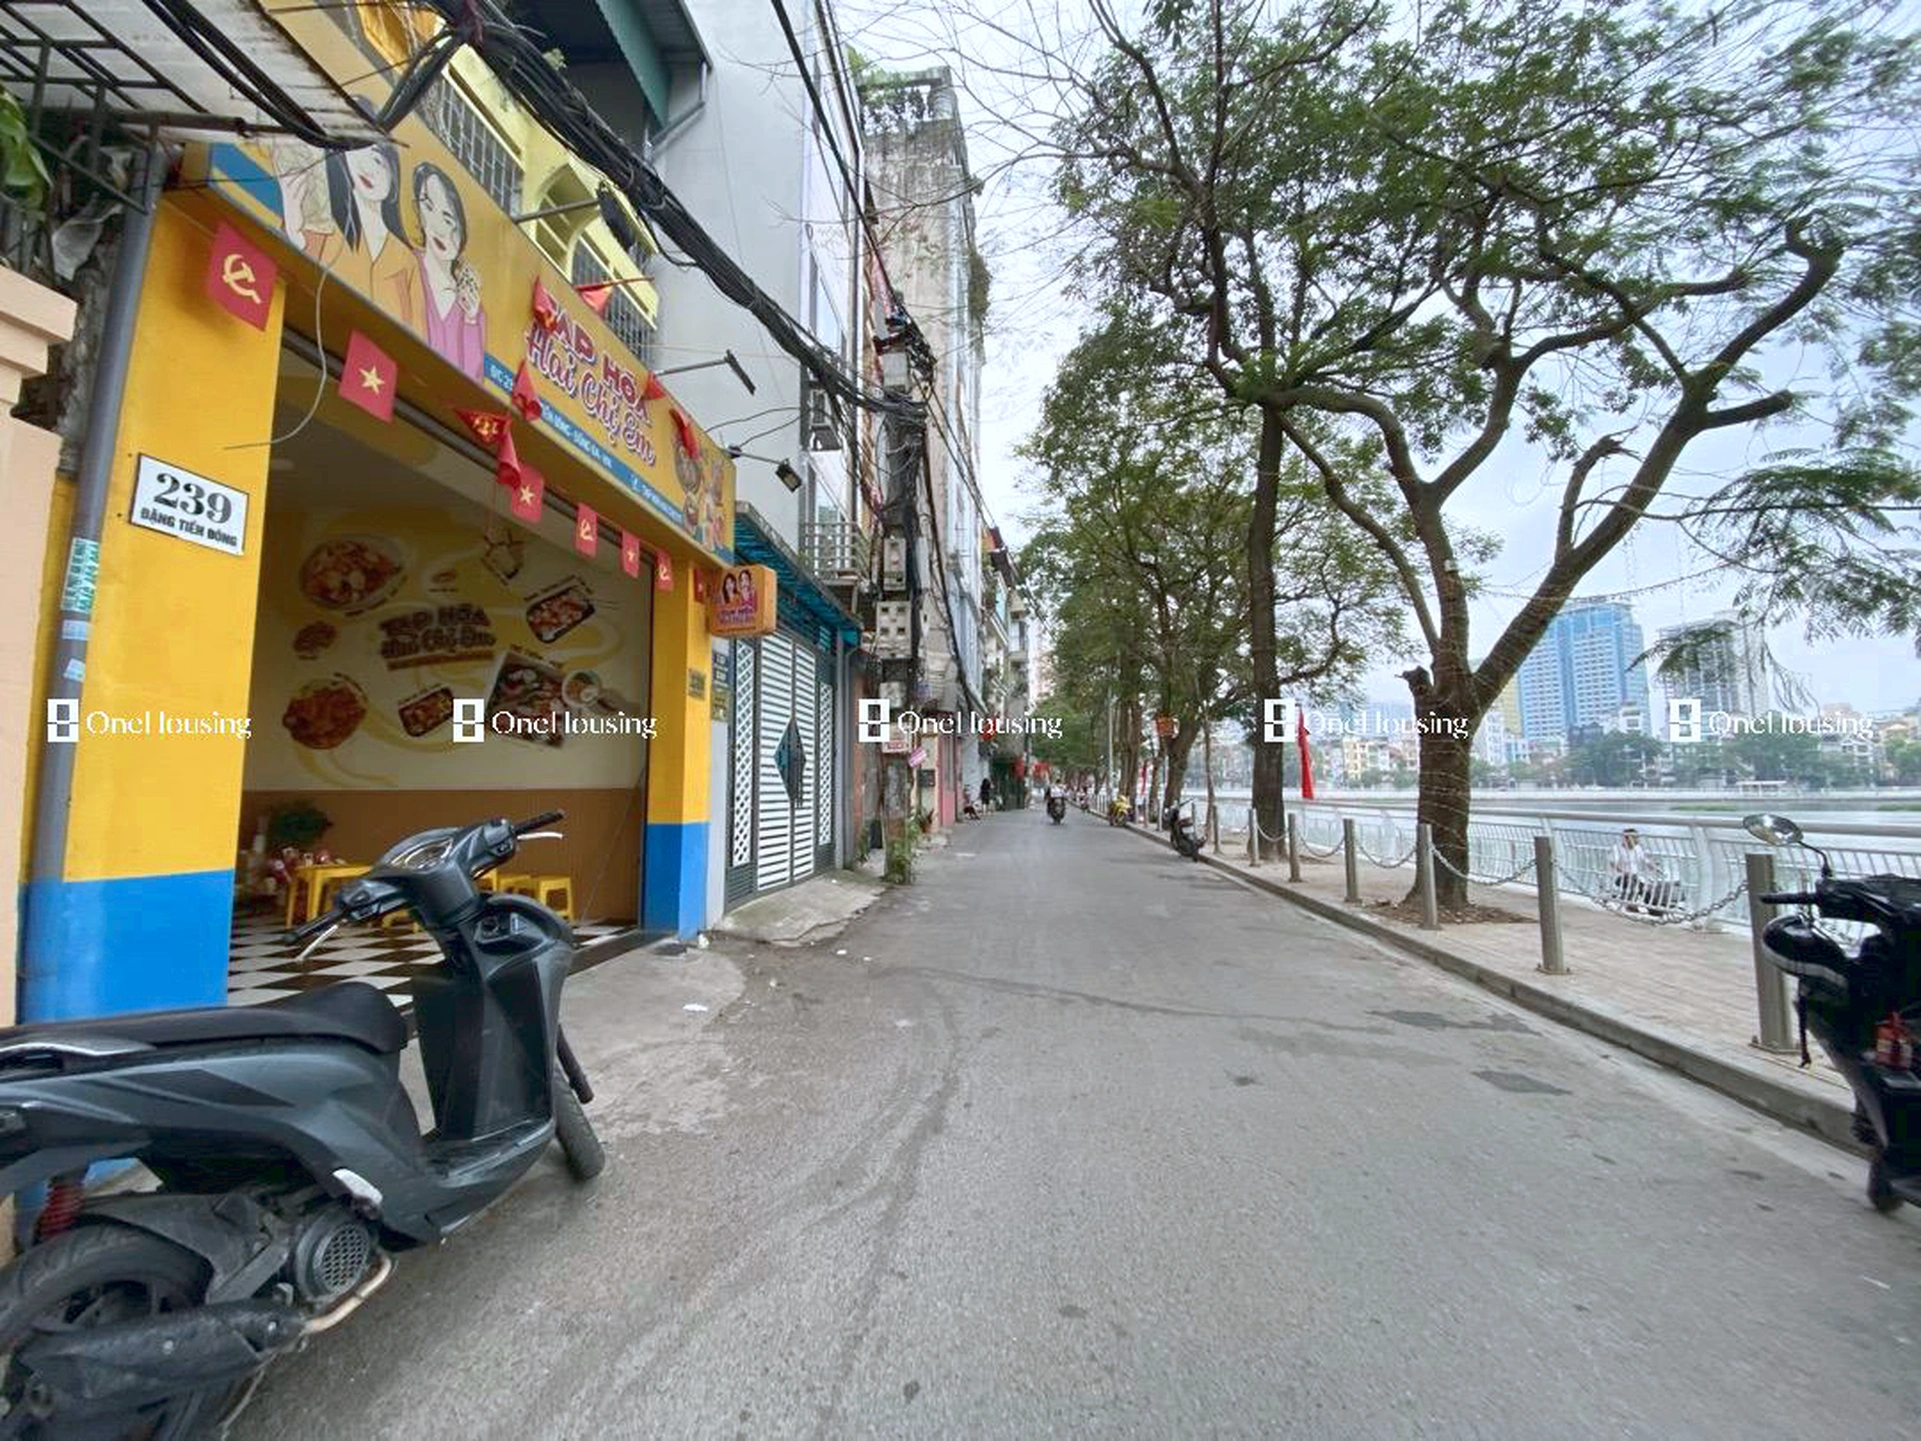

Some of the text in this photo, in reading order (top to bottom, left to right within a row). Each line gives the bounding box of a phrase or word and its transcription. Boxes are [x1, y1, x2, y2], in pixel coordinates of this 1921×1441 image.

[526, 319, 577, 398] Hai
[580, 369, 621, 447] Chị
[622, 410, 656, 468] Em
[153, 472, 232, 524] 239
[141, 507, 238, 548] ĐẶNG TIẾN ĐÔNG
